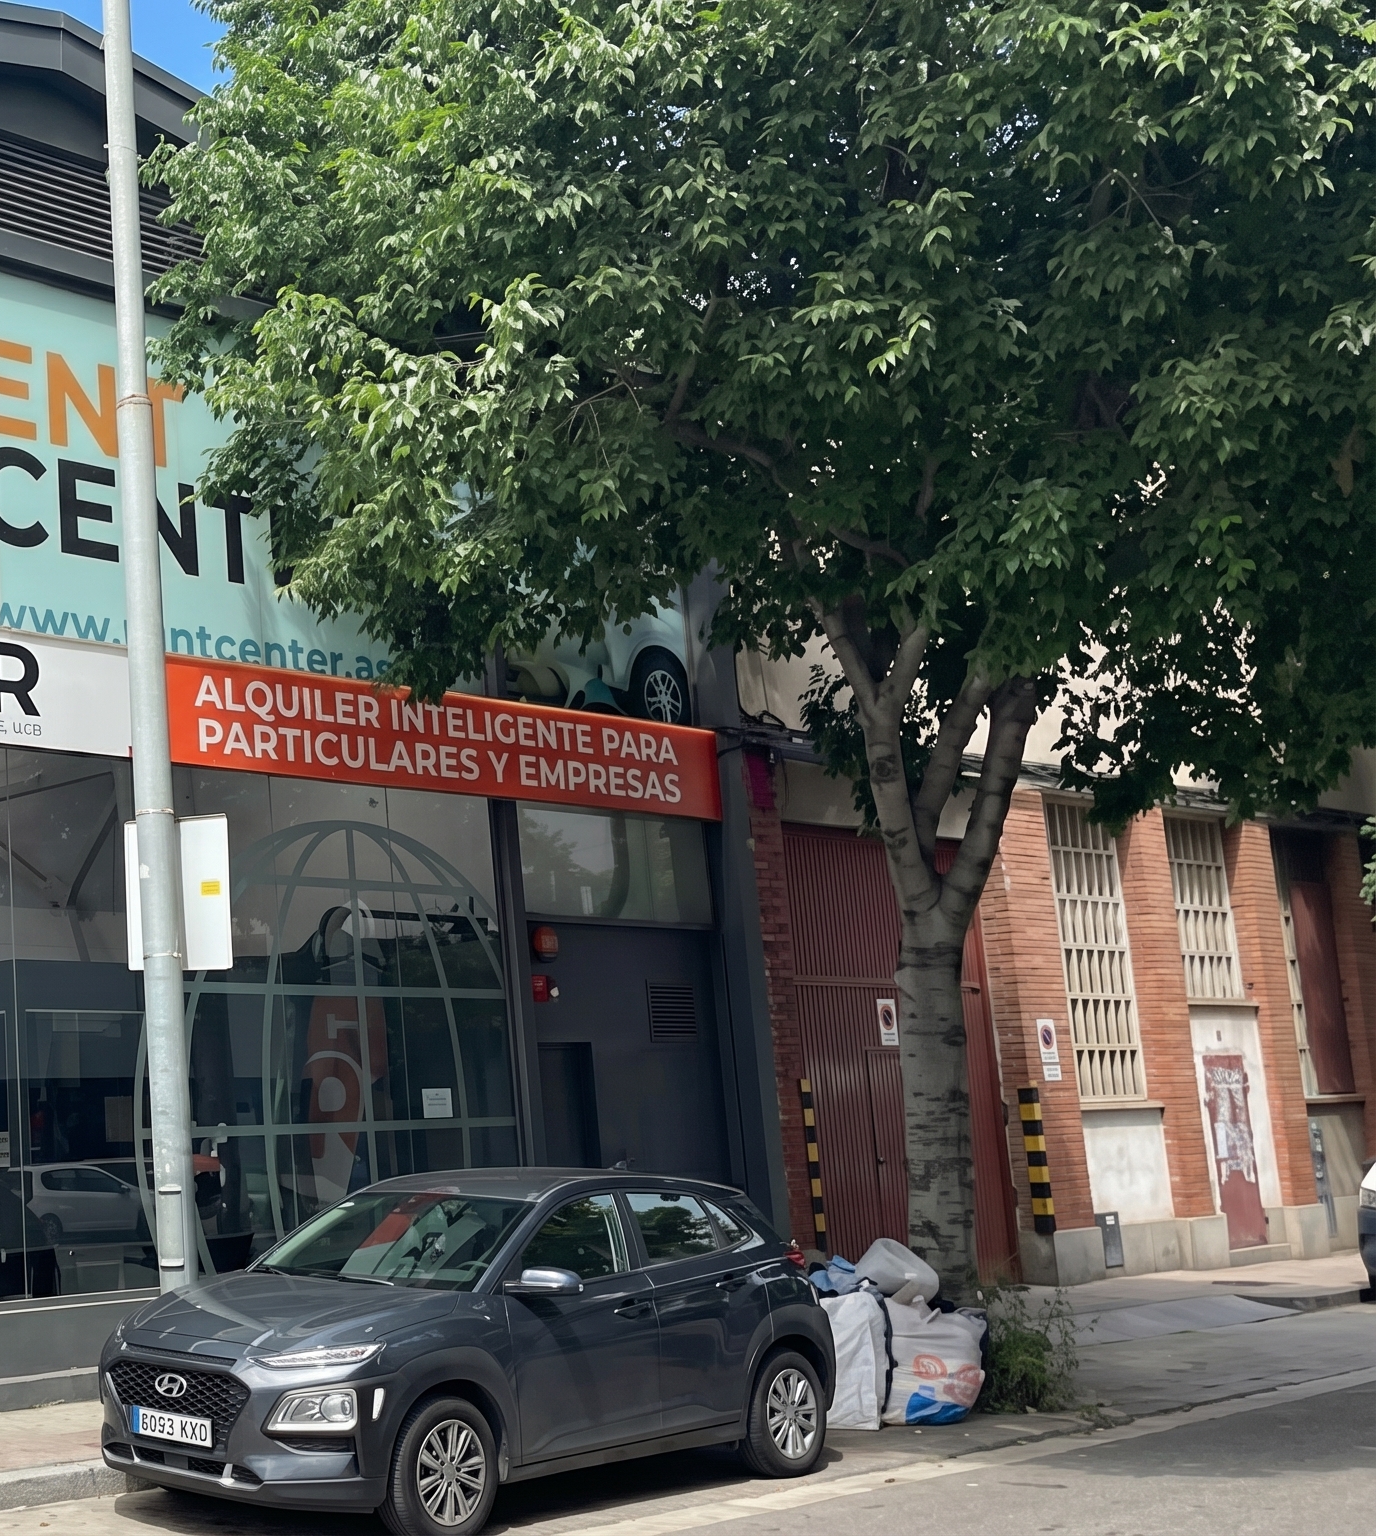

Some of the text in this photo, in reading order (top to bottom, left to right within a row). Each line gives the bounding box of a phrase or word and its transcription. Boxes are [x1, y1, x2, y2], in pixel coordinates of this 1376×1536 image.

[194, 675, 679, 766] ALQUILER INTELIGENTE PARA
[198, 717, 682, 803] PARTICULARES Y EMPRESAS
